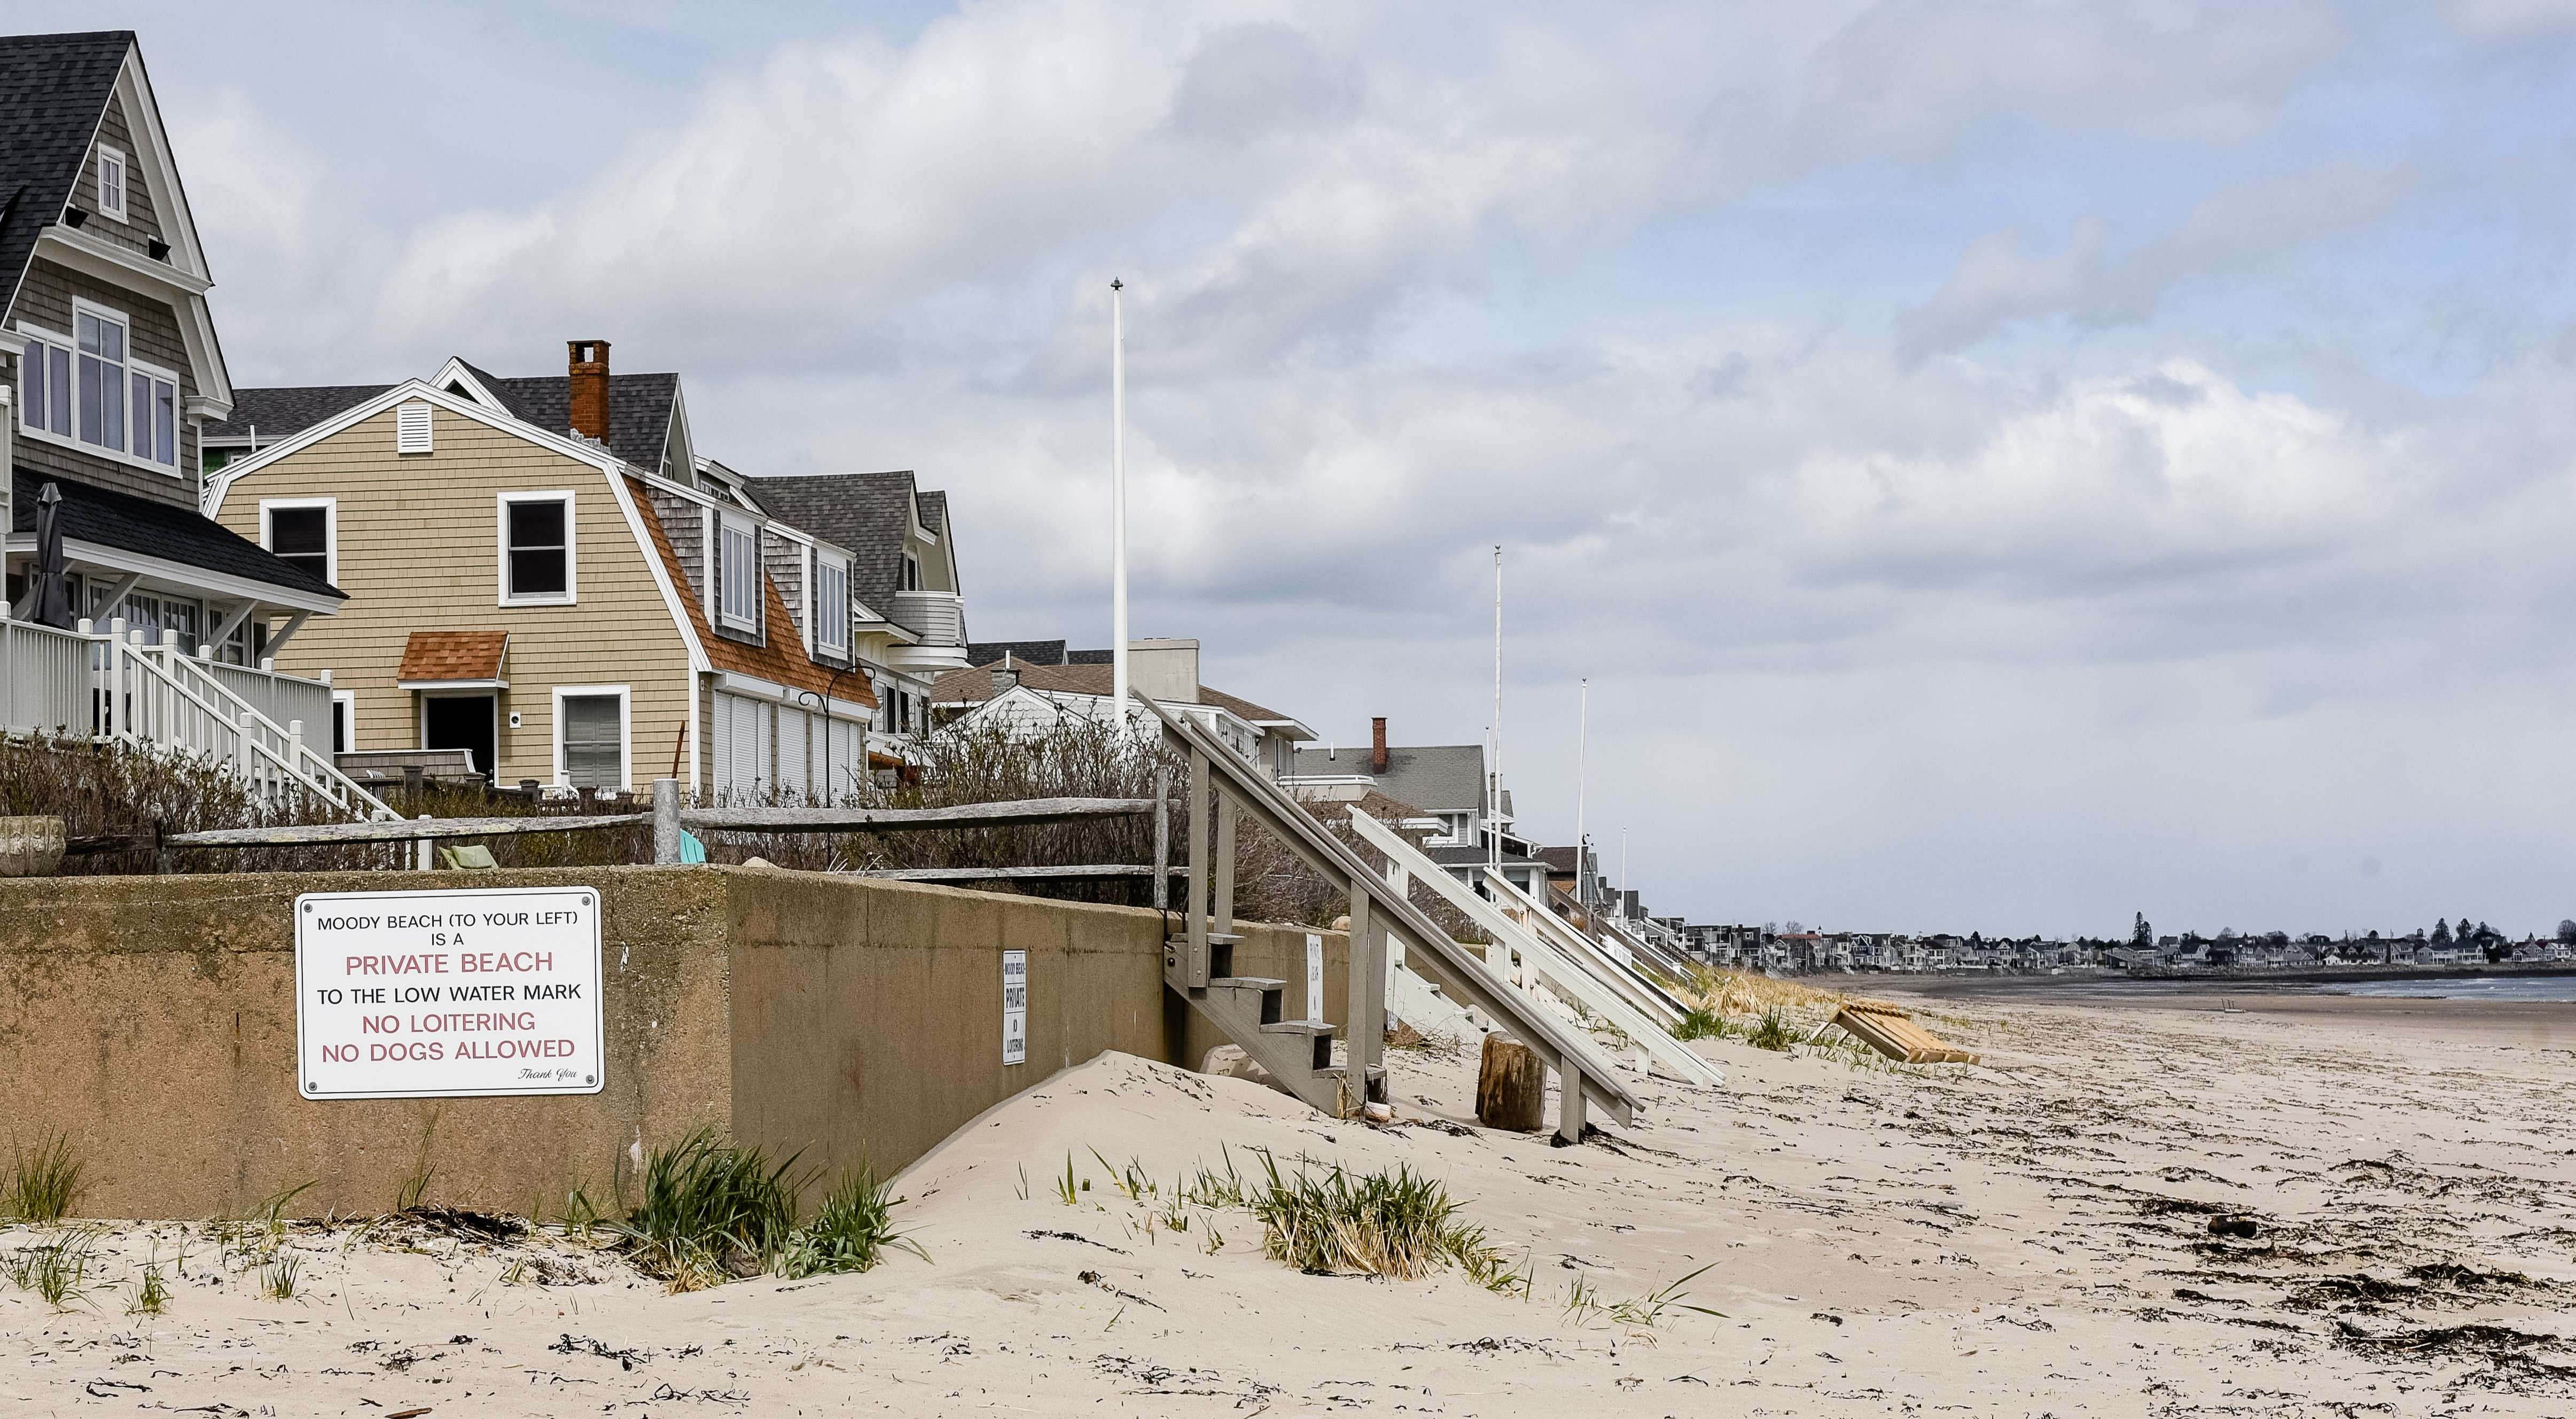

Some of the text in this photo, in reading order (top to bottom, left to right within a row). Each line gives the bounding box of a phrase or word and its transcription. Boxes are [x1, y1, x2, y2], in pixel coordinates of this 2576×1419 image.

[318, 911, 577, 931] MOODY BEACH (TO YOUR LEFT)
[432, 933, 464, 946] IS A
[347, 952, 552, 976] PRIVATE BEACH
[317, 984, 582, 1005] TO THE LOW WATER MARK
[1006, 987, 1024, 1008] PRIVATE
[363, 1012, 535, 1034] NO LOITERING
[323, 1039, 575, 1063] NO DOGS ALLOWED
[518, 1068, 577, 1082] Thank You
